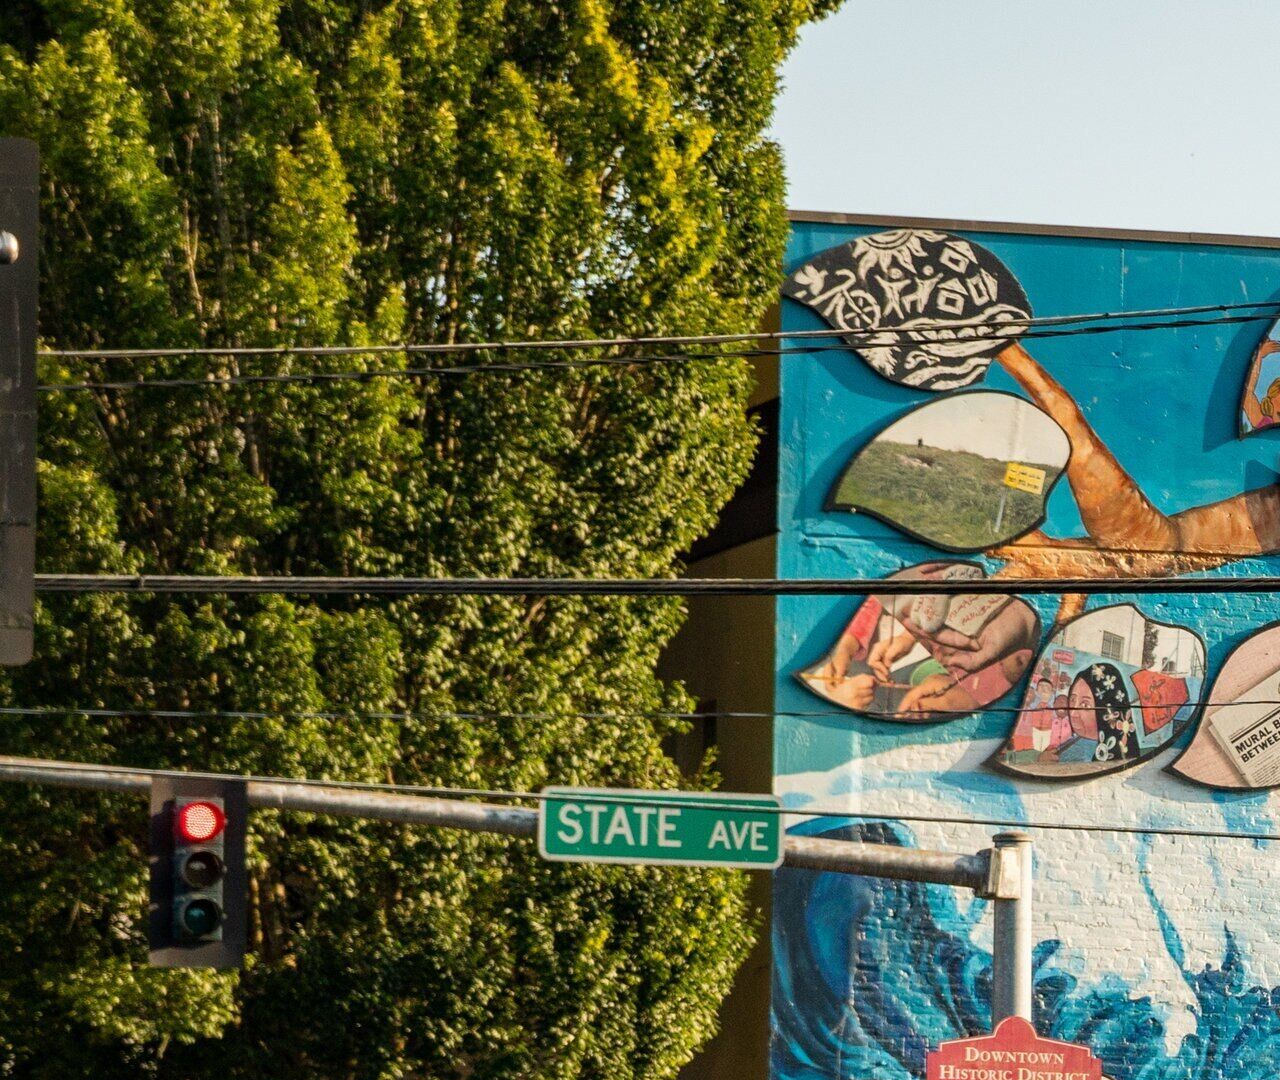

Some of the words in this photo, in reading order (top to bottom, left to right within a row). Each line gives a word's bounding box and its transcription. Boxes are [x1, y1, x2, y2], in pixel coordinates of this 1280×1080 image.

[1235, 726, 1273, 754] MURAL
[557, 803, 682, 847] STATE
[707, 820, 769, 851] AVE
